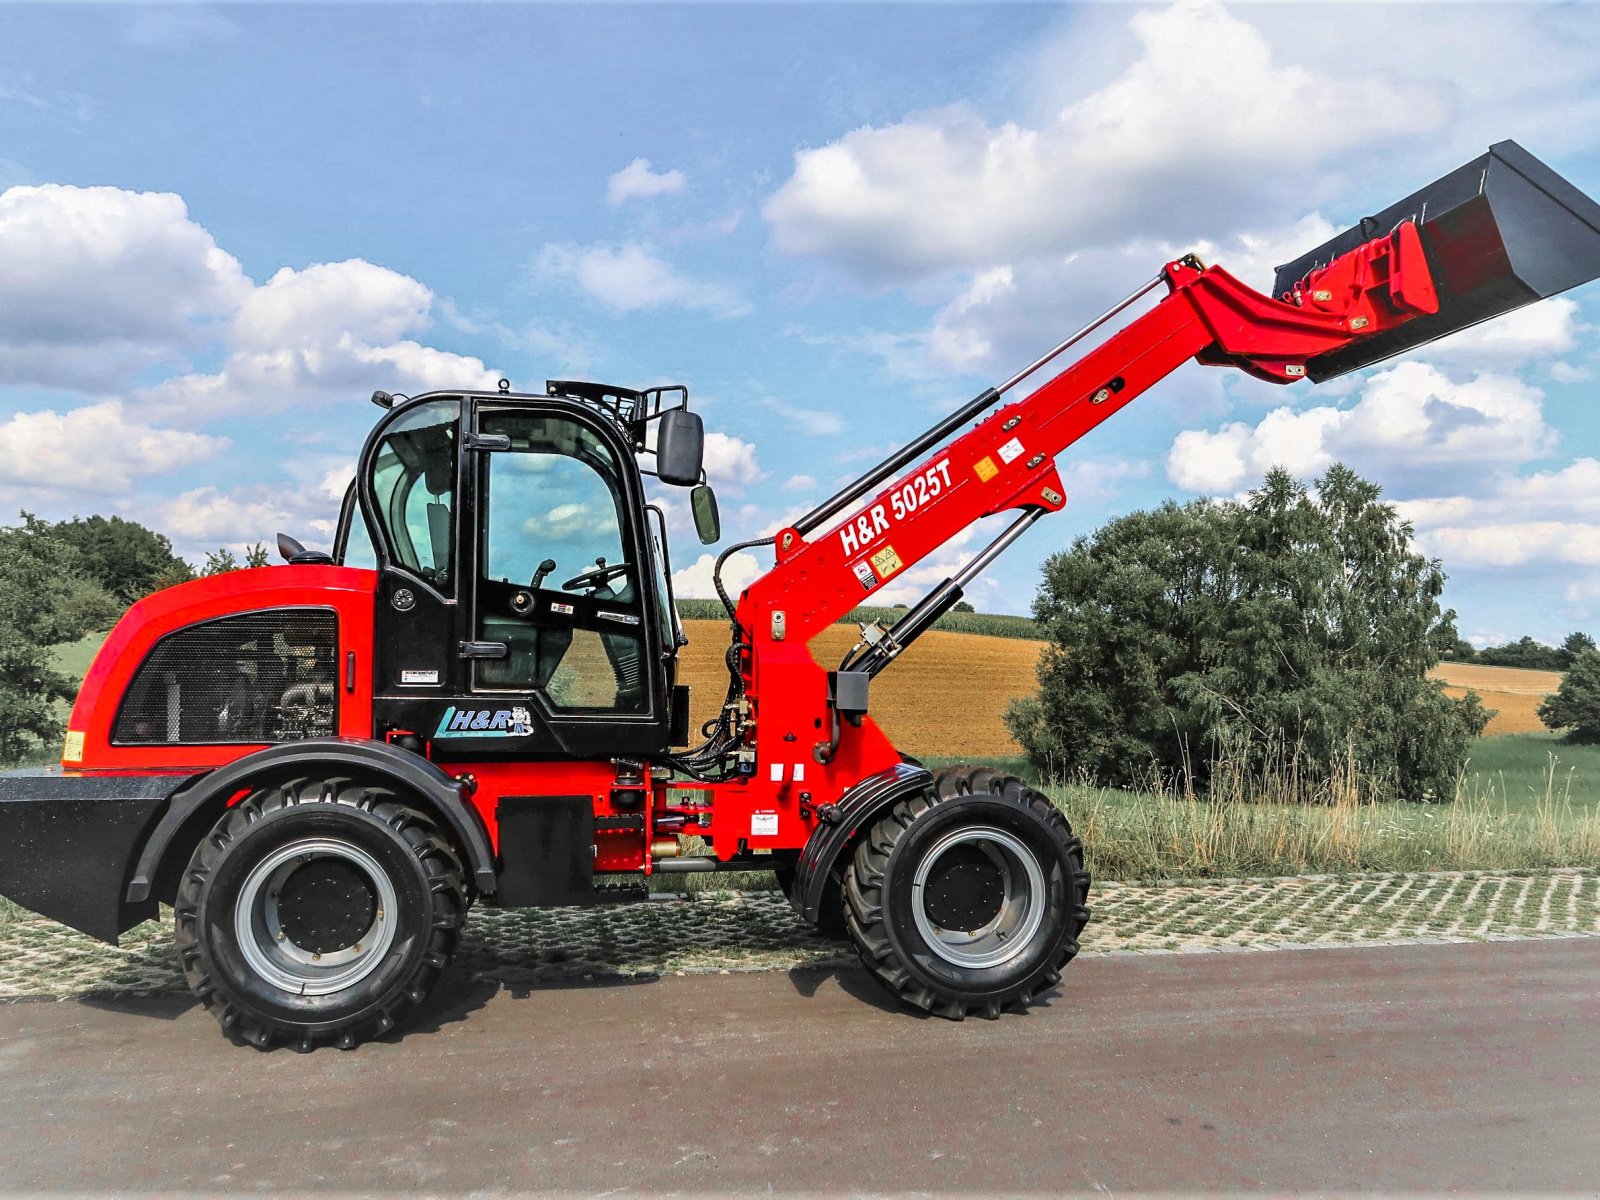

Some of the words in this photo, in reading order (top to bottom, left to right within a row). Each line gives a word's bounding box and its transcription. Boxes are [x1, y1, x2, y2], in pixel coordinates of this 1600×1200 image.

[839, 504, 890, 557] H&R
[890, 457, 952, 520] 5025T
[449, 710, 512, 730] H&R
